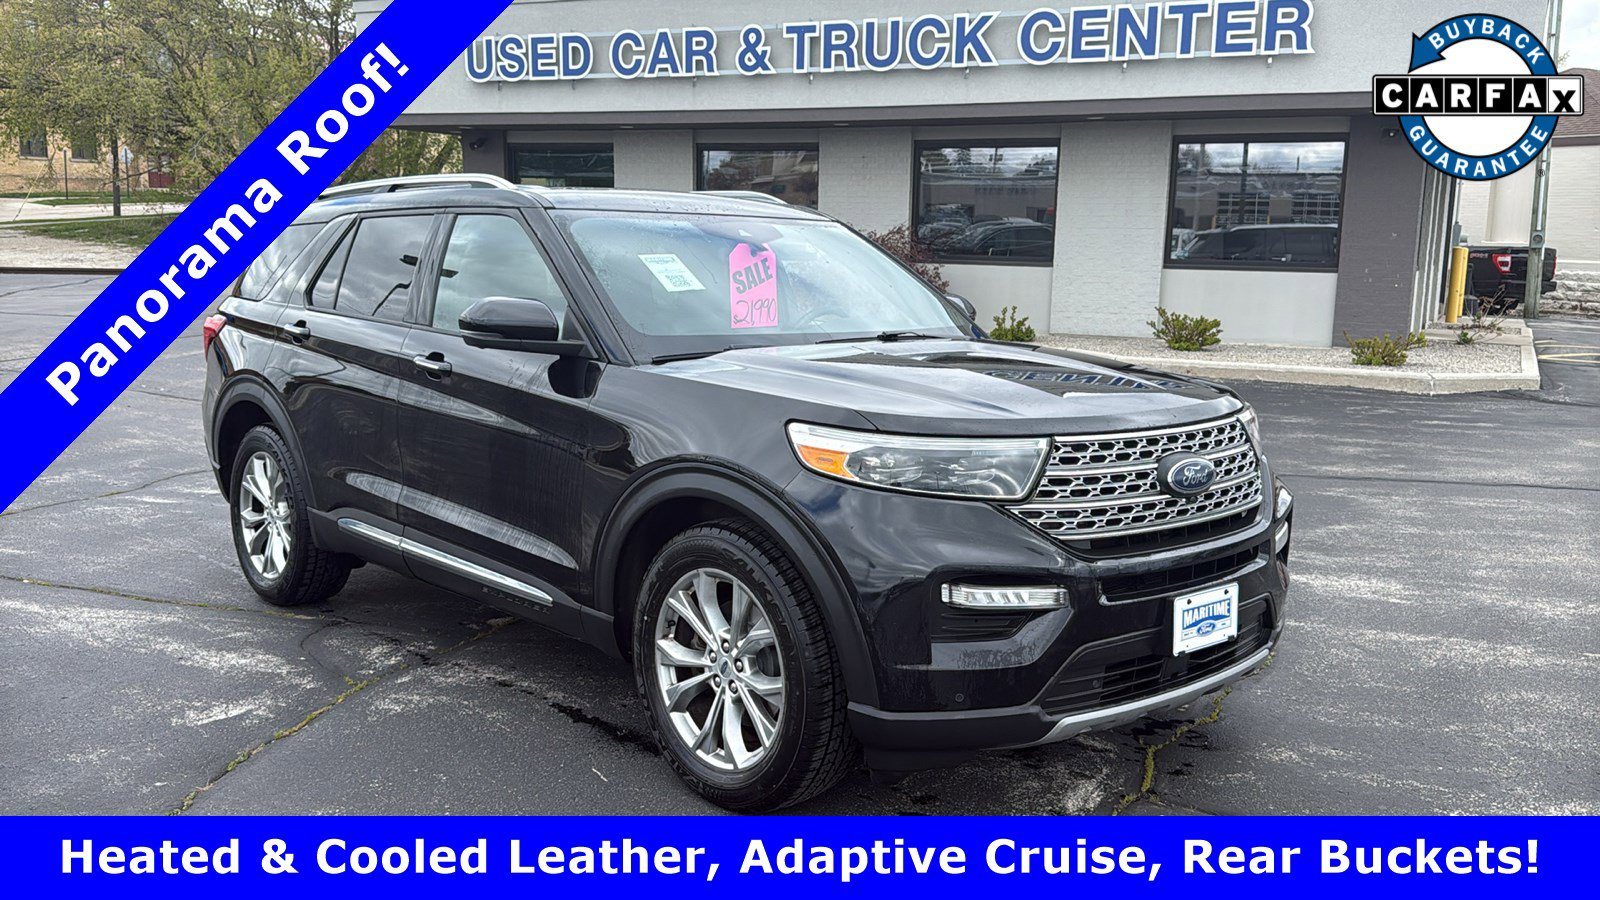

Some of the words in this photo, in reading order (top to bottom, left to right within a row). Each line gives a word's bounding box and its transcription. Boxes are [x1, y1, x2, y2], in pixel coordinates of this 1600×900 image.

[464, 32, 594, 83] USED
[609, 26, 719, 80] CAR
[735, 23, 776, 76] &
[783, 11, 1001, 73] TRUCK
[1016, 0, 1315, 66] CENTER
[732, 257, 774, 294] SALE
[1183, 600, 1231, 629] MARITIME
